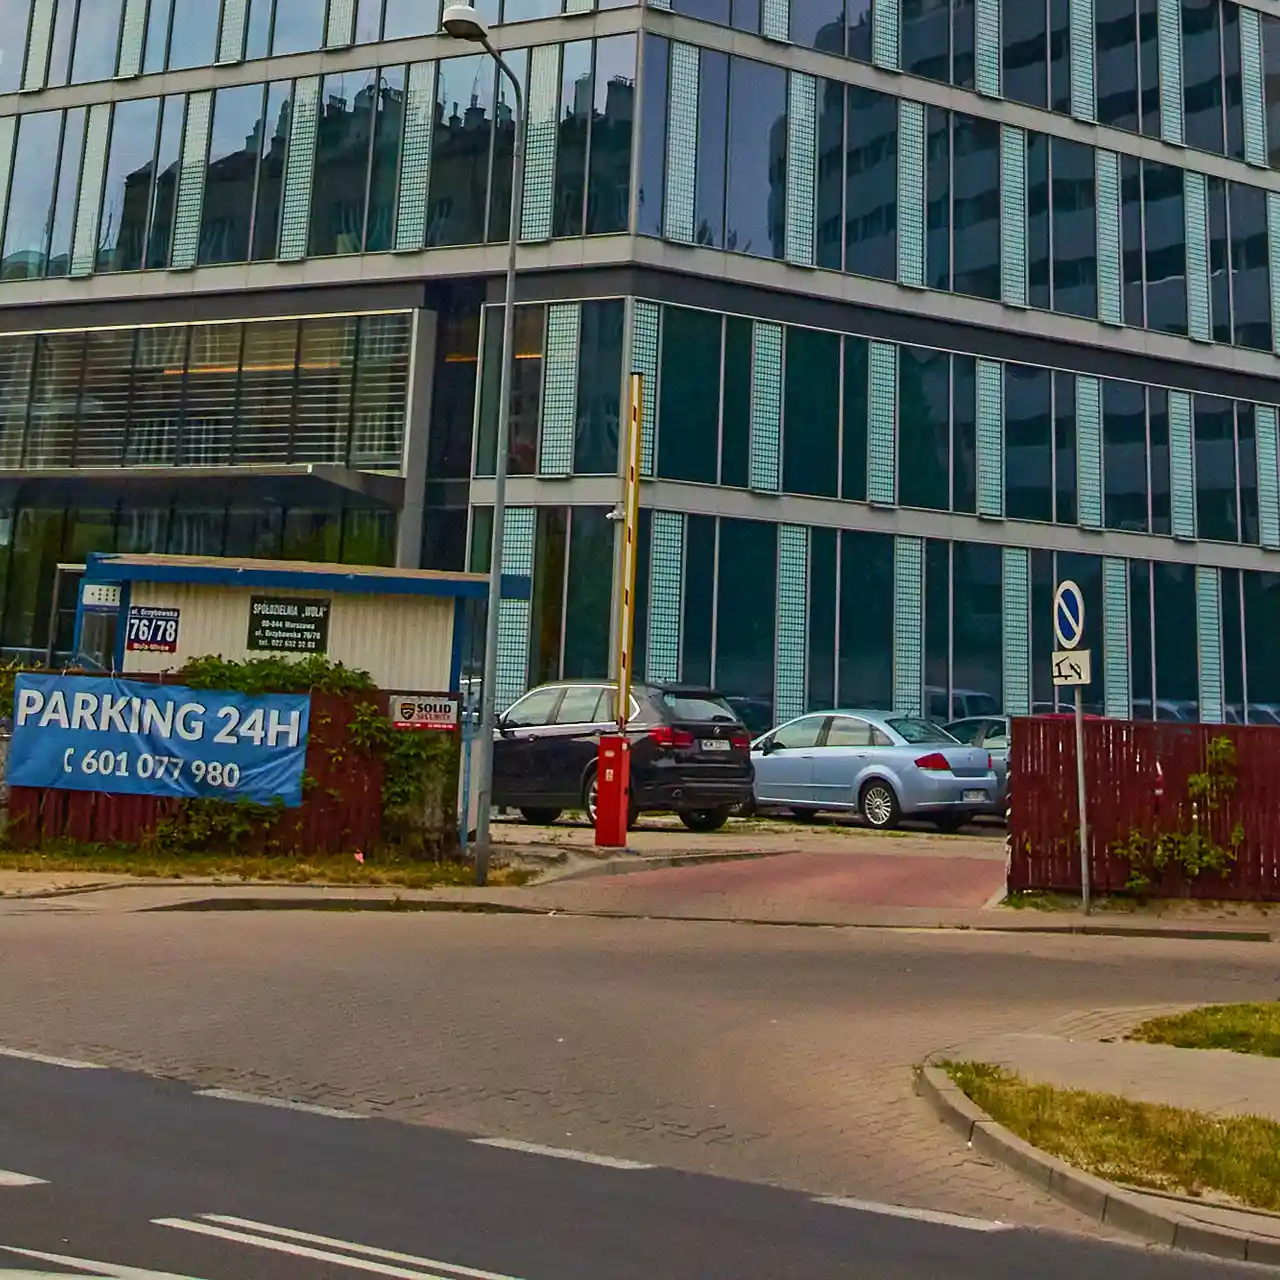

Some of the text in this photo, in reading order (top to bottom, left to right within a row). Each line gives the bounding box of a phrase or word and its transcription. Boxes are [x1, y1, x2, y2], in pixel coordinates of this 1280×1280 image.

[130, 619, 177, 642] 76/78
[16, 689, 301, 748] PARKING 24H
[416, 703, 452, 714] SOLID
[81, 749, 241, 788] 601 077 980
